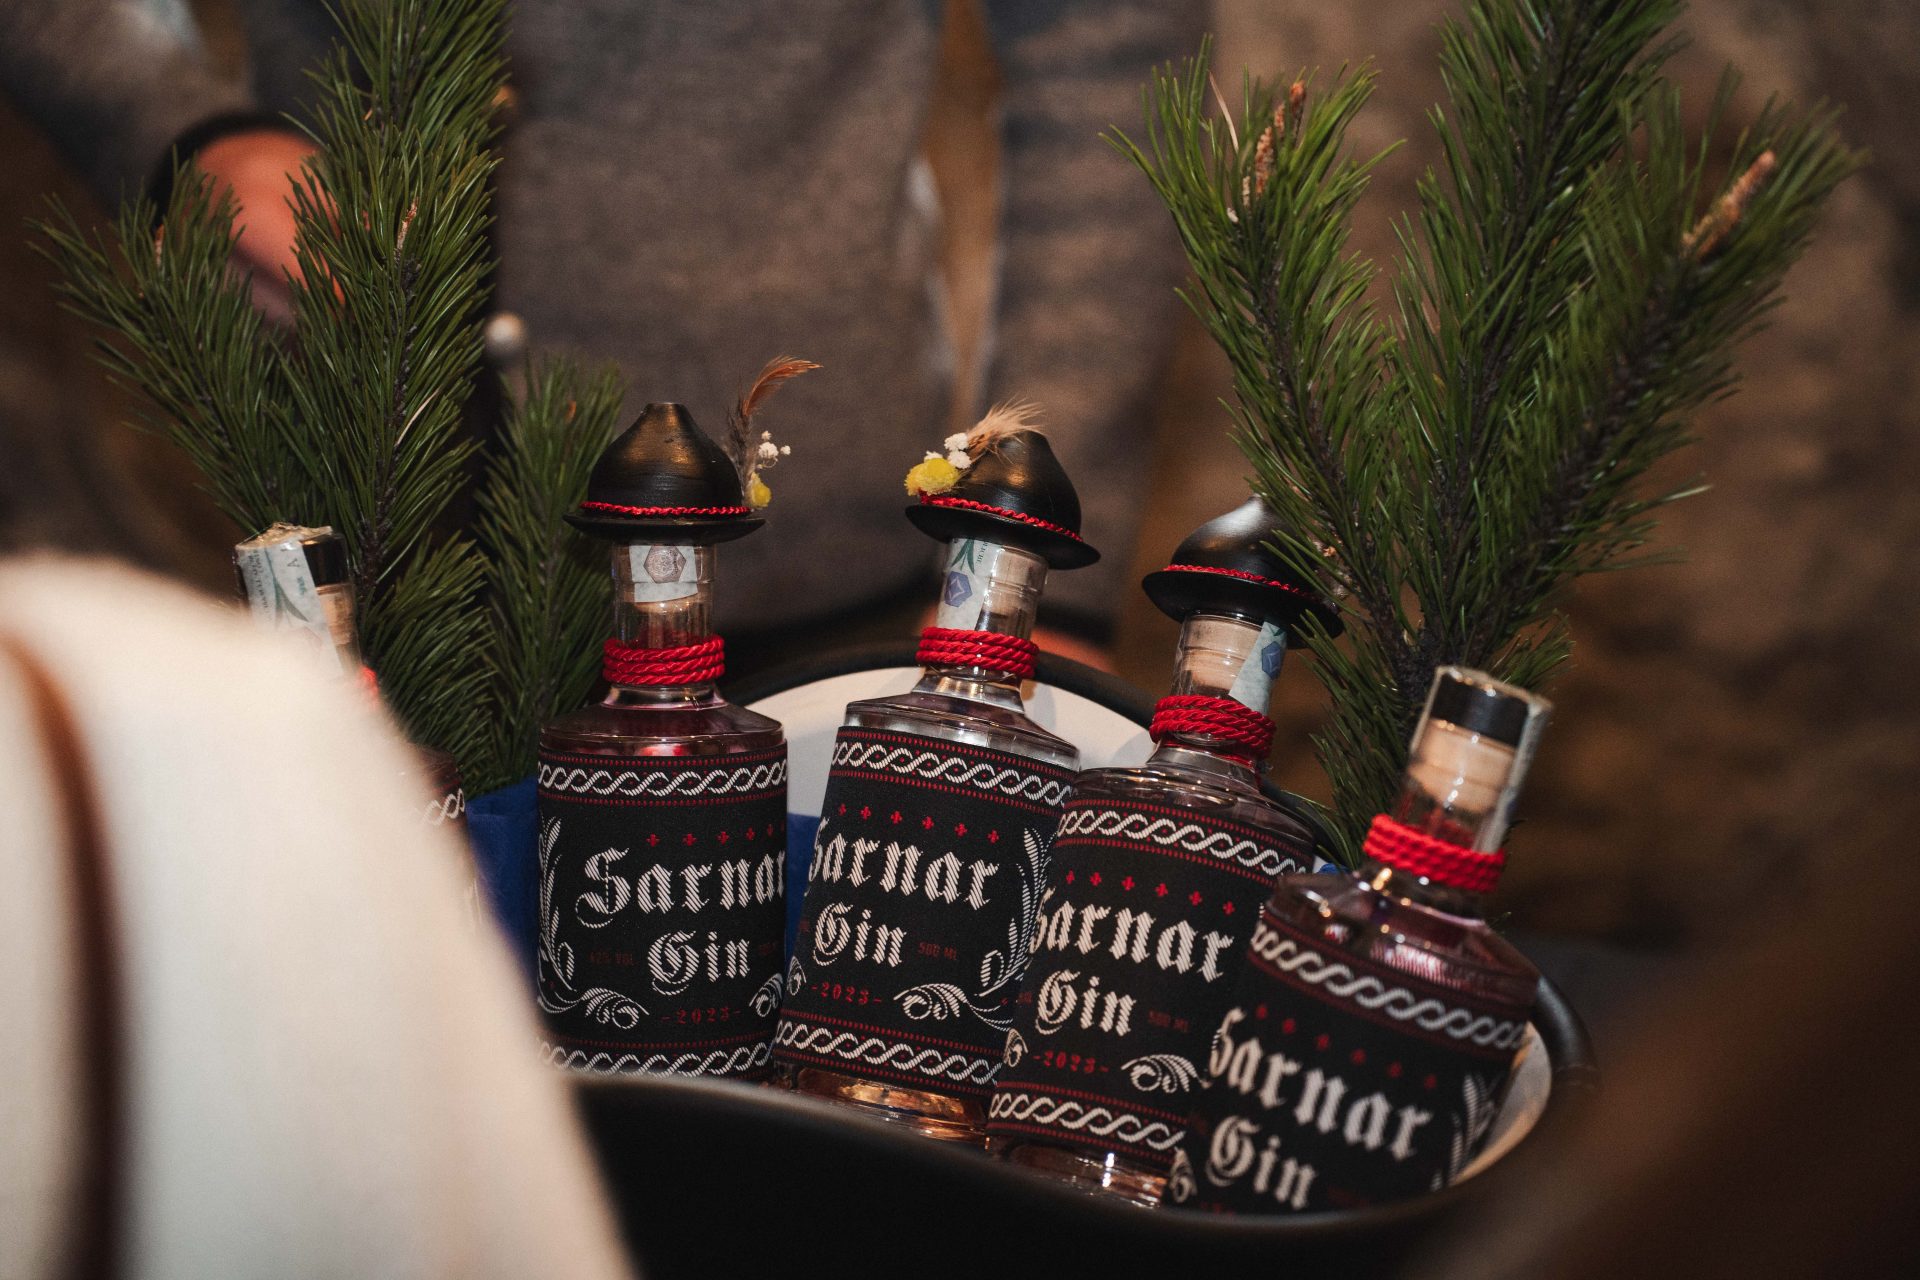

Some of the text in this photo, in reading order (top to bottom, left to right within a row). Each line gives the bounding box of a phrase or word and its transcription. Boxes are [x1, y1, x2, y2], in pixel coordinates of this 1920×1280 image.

[648, 931, 750, 996] Gin
[812, 902, 907, 968] Gin
[1035, 969, 1136, 1036] Gin
[1205, 1115, 1317, 1210] Gin
